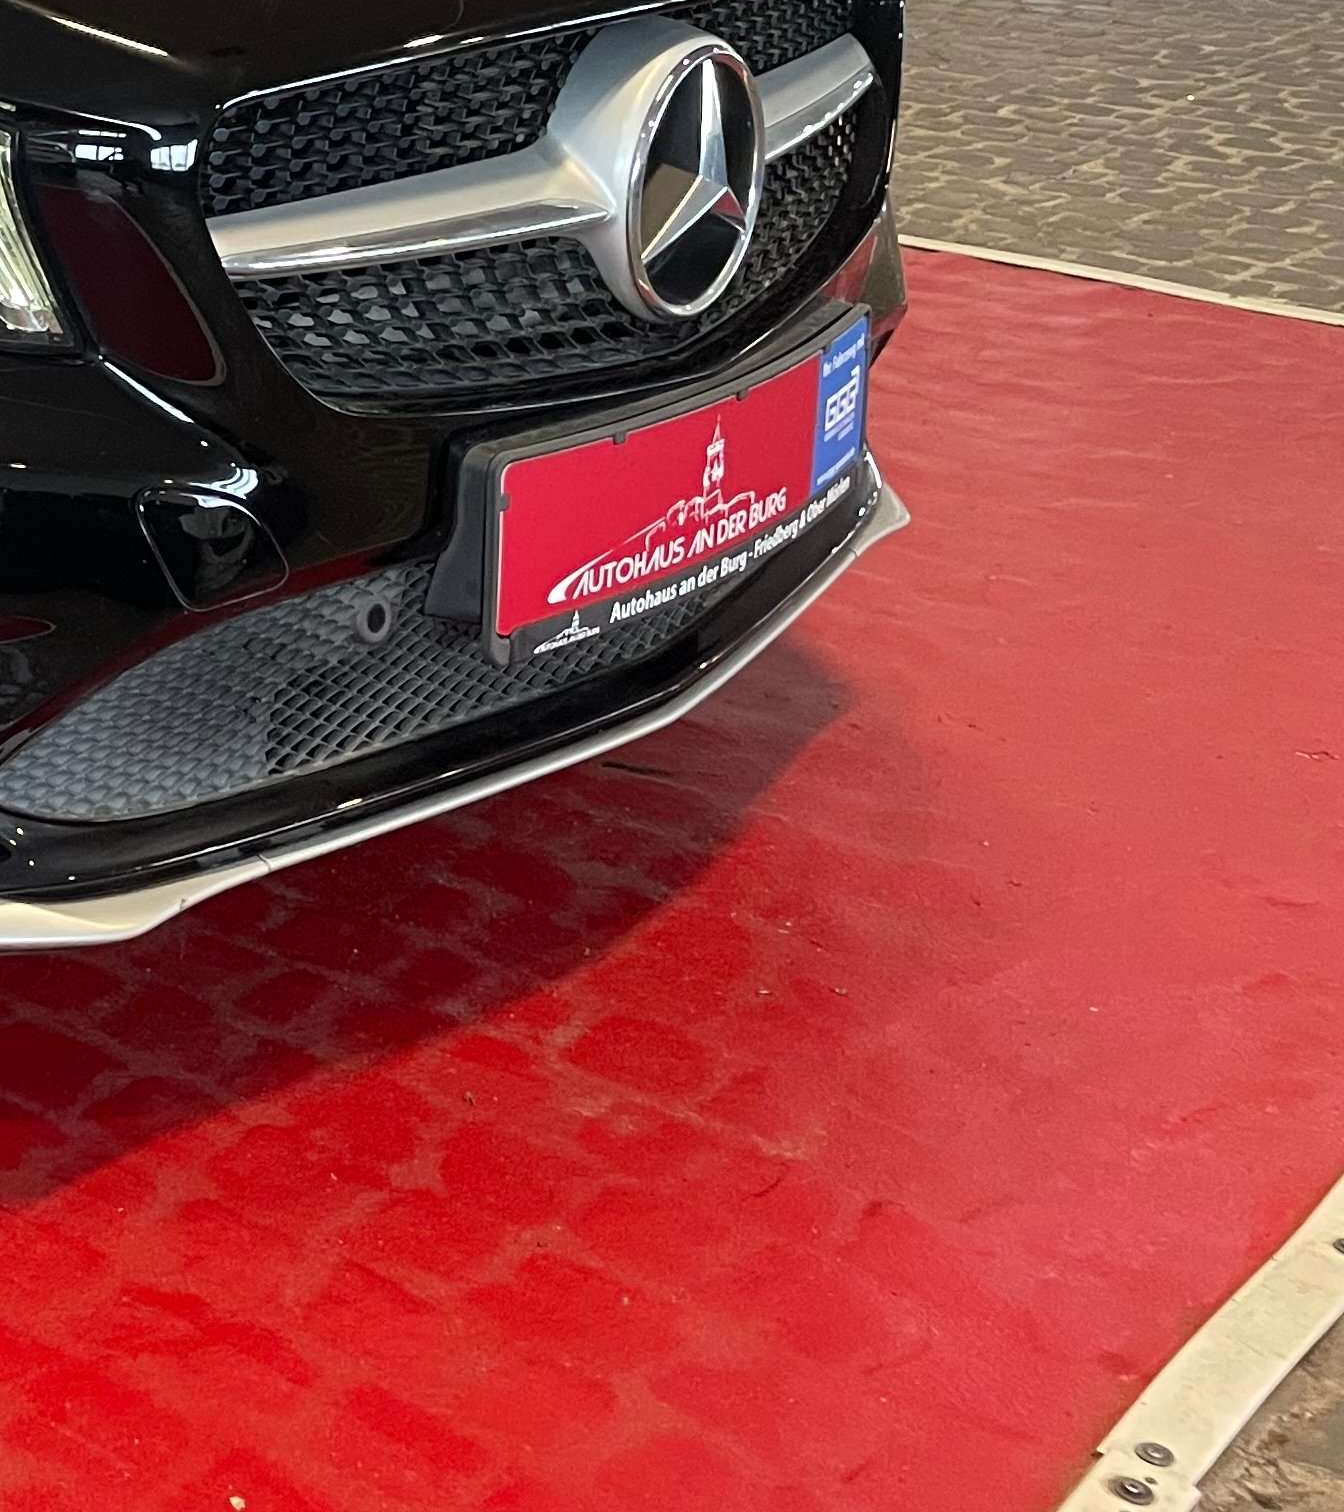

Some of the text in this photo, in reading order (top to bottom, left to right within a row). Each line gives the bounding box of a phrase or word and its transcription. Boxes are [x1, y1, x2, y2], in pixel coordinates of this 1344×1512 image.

[571, 487, 788, 600] AUTOHAUS AN DER BURG
[609, 584, 678, 624] Autohaus
[678, 577, 696, 595] an
[697, 564, 720, 587] der
[720, 550, 748, 577] Burg
[753, 518, 799, 559] Friedberg
